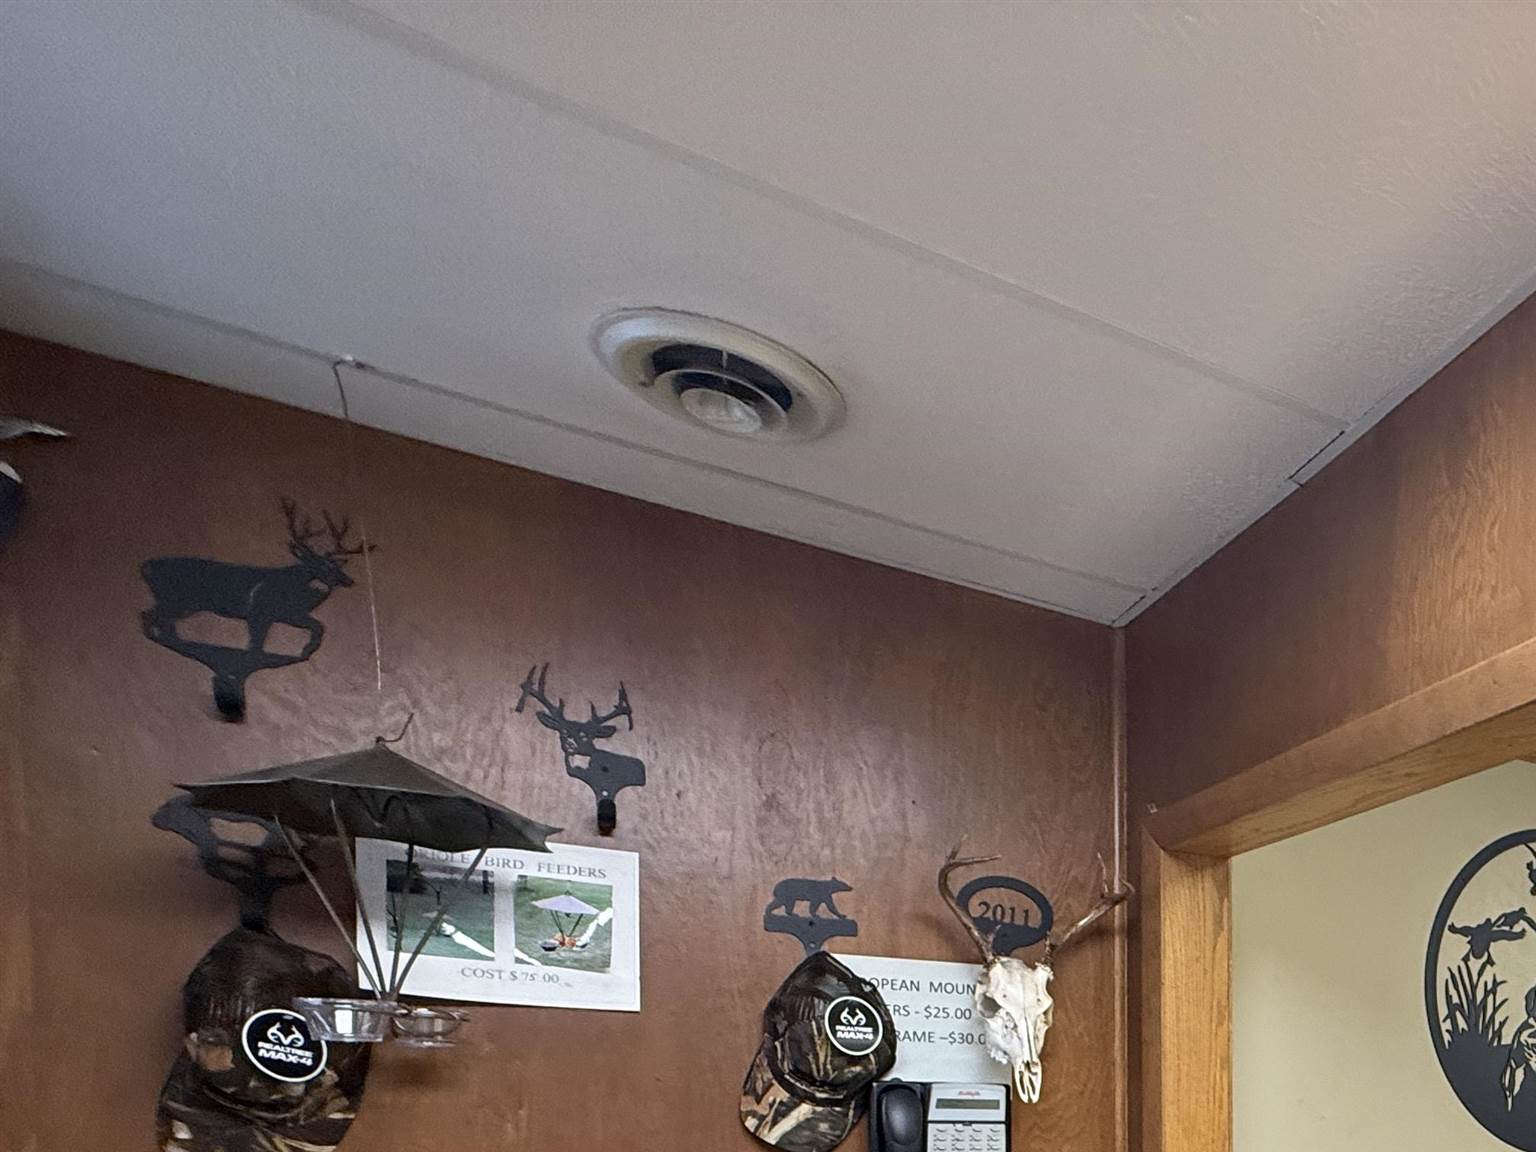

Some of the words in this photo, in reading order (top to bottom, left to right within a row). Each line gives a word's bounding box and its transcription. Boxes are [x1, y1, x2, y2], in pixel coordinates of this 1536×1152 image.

[485, 856, 524, 869] BIRD
[537, 862, 607, 879] FEEDERS
[978, 901, 1030, 926] 2011
[461, 967, 504, 980] COST
[870, 977, 920, 992] OPEAN
[929, 981, 976, 995] MOUN
[886, 1004, 911, 1017] RS
[924, 1004, 972, 1020] $25.00
[895, 1030, 935, 1043] RAME
